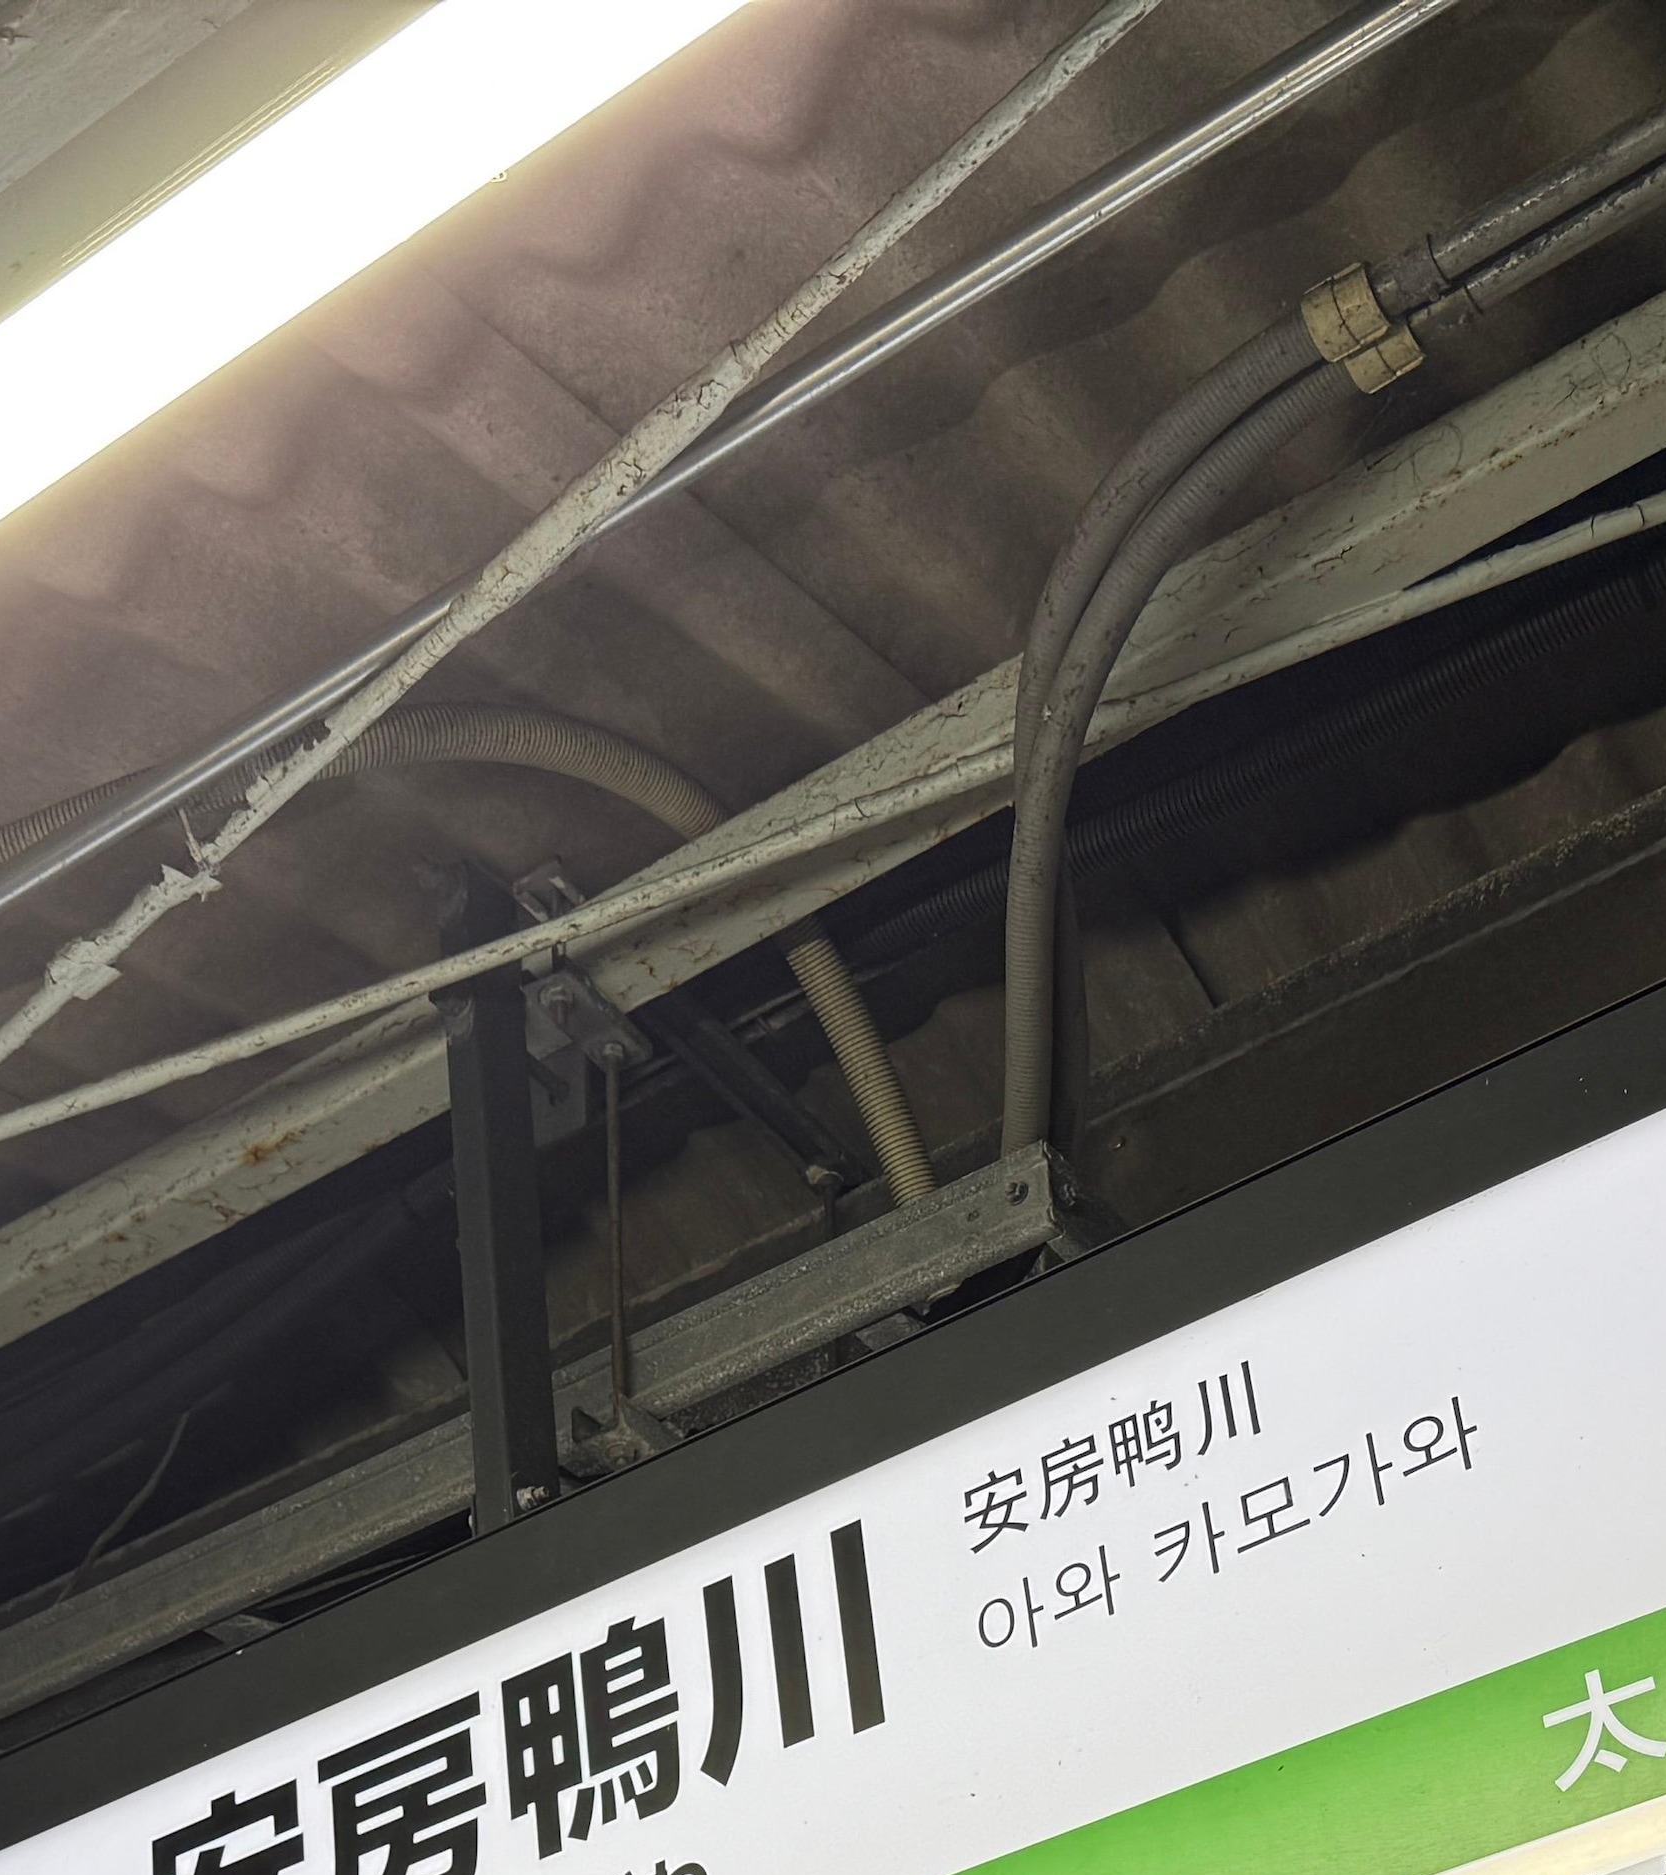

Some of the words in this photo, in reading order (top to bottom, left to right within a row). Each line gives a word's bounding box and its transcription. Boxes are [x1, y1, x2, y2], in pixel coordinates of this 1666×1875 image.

[963, 1359, 1263, 1555] 安房鸭川
[977, 1543, 1121, 1650] 아와
[1153, 1395, 1480, 1585] 카모가와
